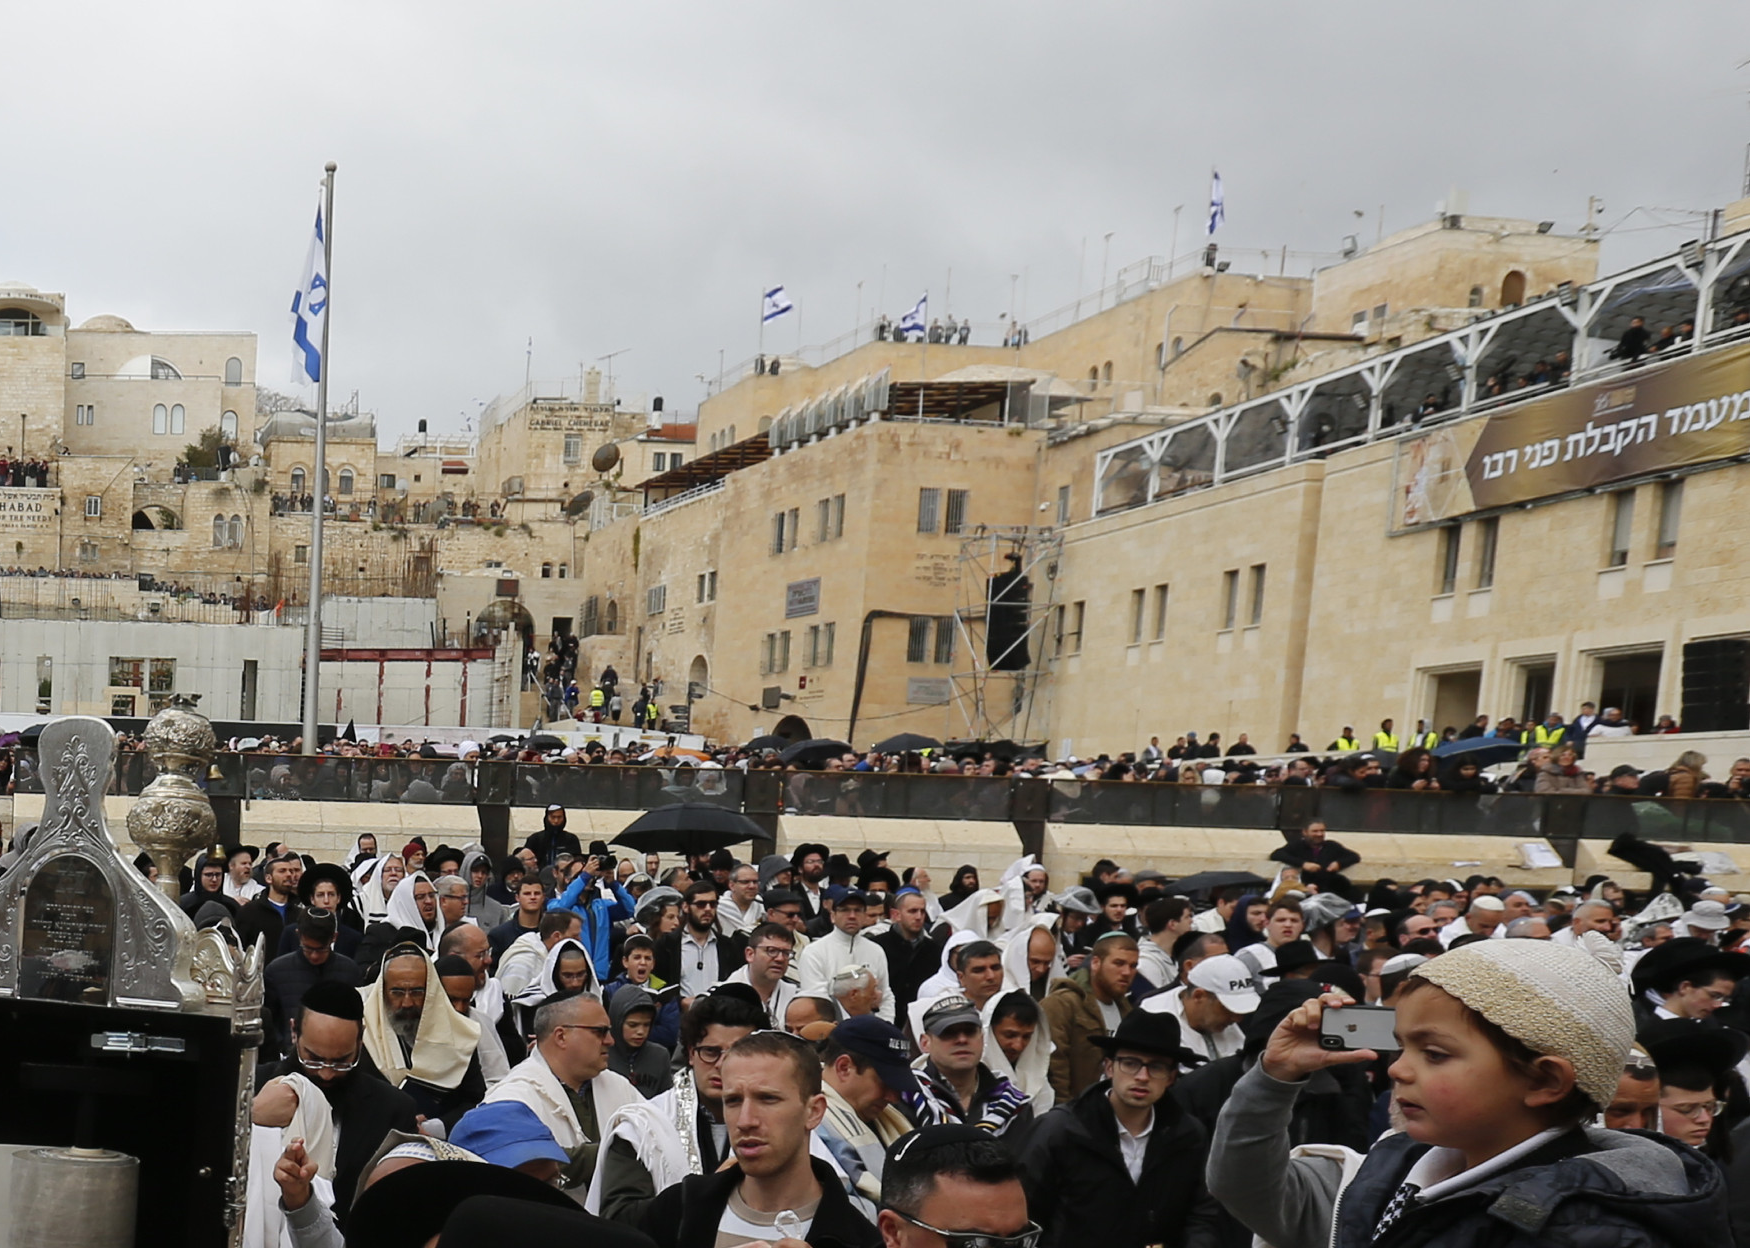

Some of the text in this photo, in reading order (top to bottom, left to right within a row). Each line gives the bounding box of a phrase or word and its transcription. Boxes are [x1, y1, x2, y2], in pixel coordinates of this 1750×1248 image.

[1664, 390, 1750, 436] מעמד
[1523, 438, 1560, 470] פני
[1562, 413, 1658, 457] הקבלת
[1482, 448, 1519, 480] רבו
